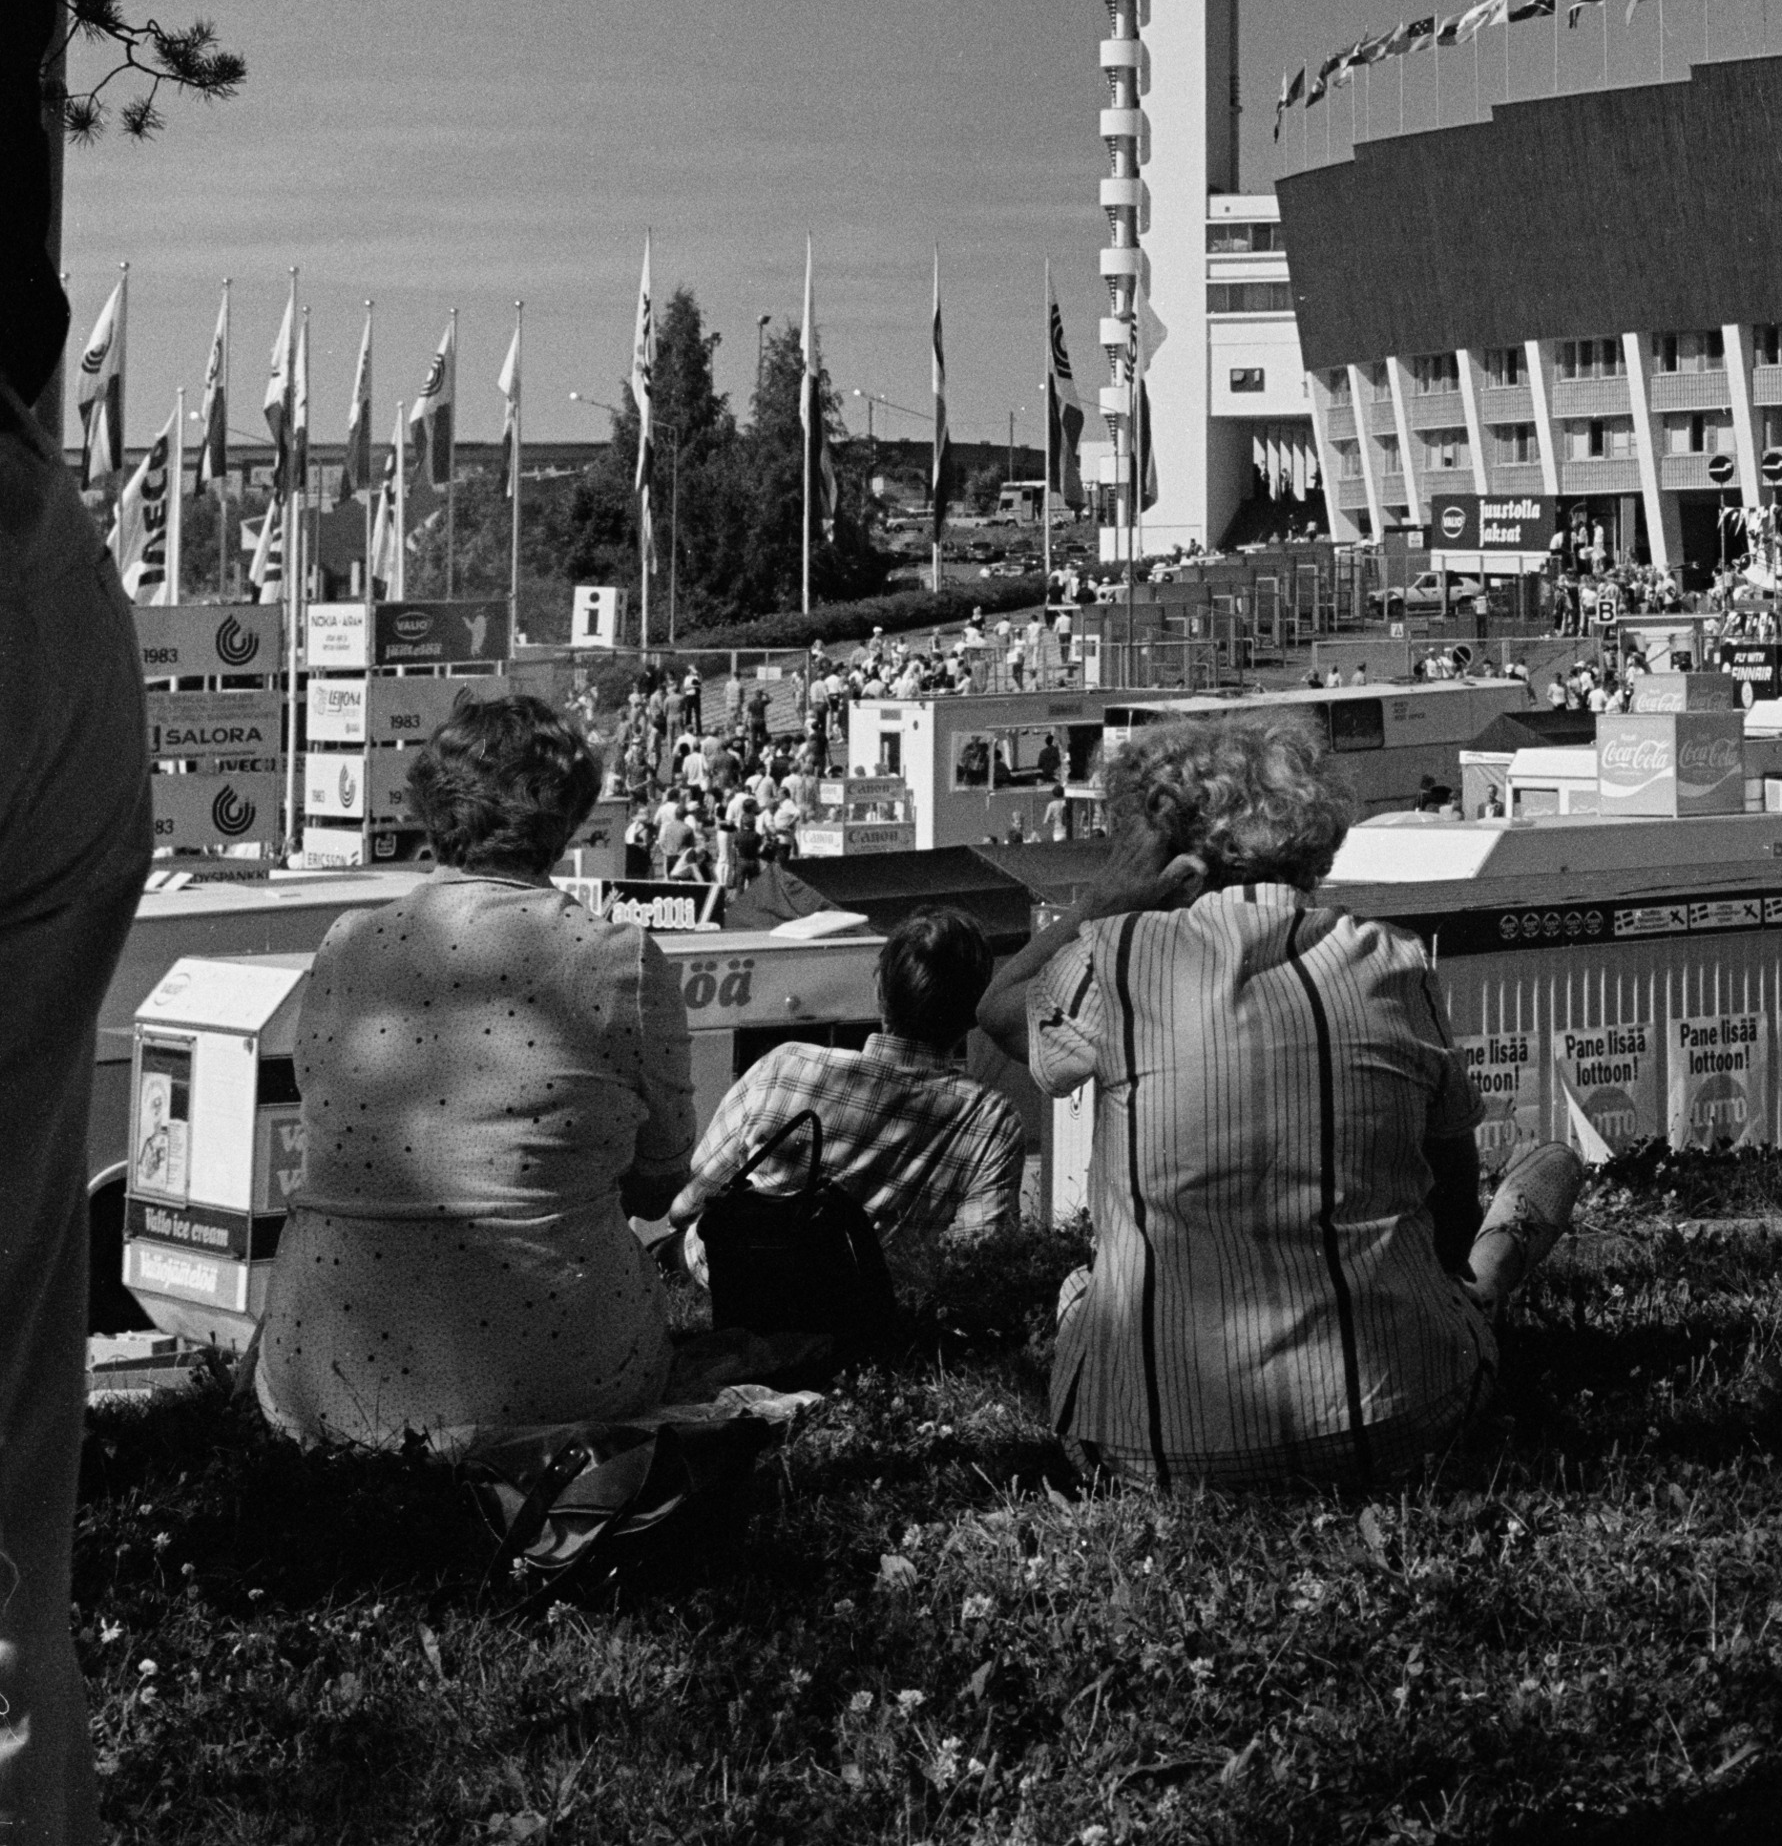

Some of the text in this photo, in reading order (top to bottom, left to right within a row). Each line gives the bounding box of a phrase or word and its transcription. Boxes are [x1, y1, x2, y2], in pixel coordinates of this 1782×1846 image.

[1479, 499, 1541, 525] juustolla
[1443, 516, 1465, 528] VALIO
[1479, 522, 1521, 548] jaksat
[1600, 602, 1613, 621] B
[396, 620, 428, 631] VALIO
[143, 647, 178, 664] 1983
[1734, 652, 1747, 663] FLY
[1732, 665, 1773, 681] FINNAIR
[390, 714, 421, 729] 1983
[166, 727, 263, 745] SALORA
[389, 790, 402, 804] 19
[847, 783, 890, 796] Canon
[155, 818, 174, 835] 83
[848, 829, 899, 844] Canon
[192, 869, 270, 883] DYSPANKKI
[1680, 1017, 1758, 1048] Pane lisää
[1466, 1036, 1529, 1066] ne lisää
[1565, 1027, 1647, 1060] Pane lisää
[1690, 1044, 1750, 1075] lottoon!
[1470, 1065, 1520, 1094] toon!
[1576, 1056, 1638, 1087] lottoon!
[178, 1212, 195, 1240] ice
[196, 1222, 229, 1248] cream
